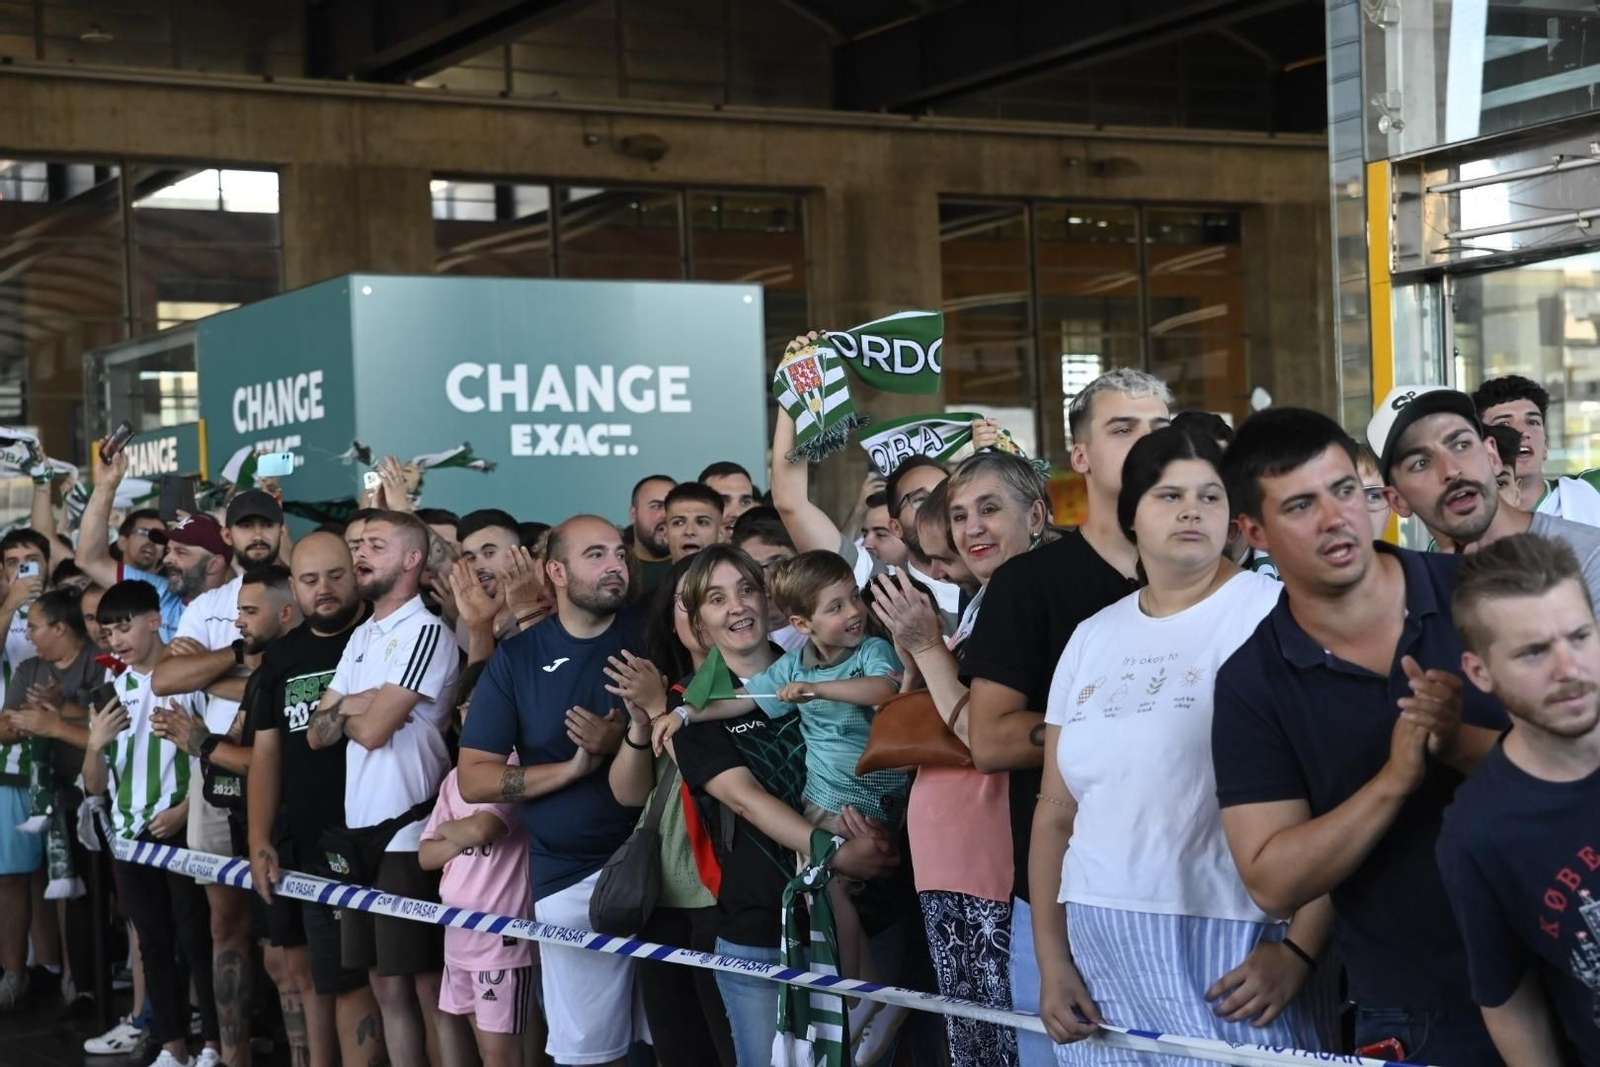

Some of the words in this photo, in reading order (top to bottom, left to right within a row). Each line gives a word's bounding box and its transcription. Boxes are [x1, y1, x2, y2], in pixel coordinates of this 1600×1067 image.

[445, 362, 692, 414] CHANGE
[232, 369, 325, 434] CHANGE
[295, 883, 316, 897] PASAR
[401, 900, 414, 915] NO
[412, 902, 438, 919] PASAR
[540, 924, 557, 938] NO
[554, 926, 588, 944] PASAR
